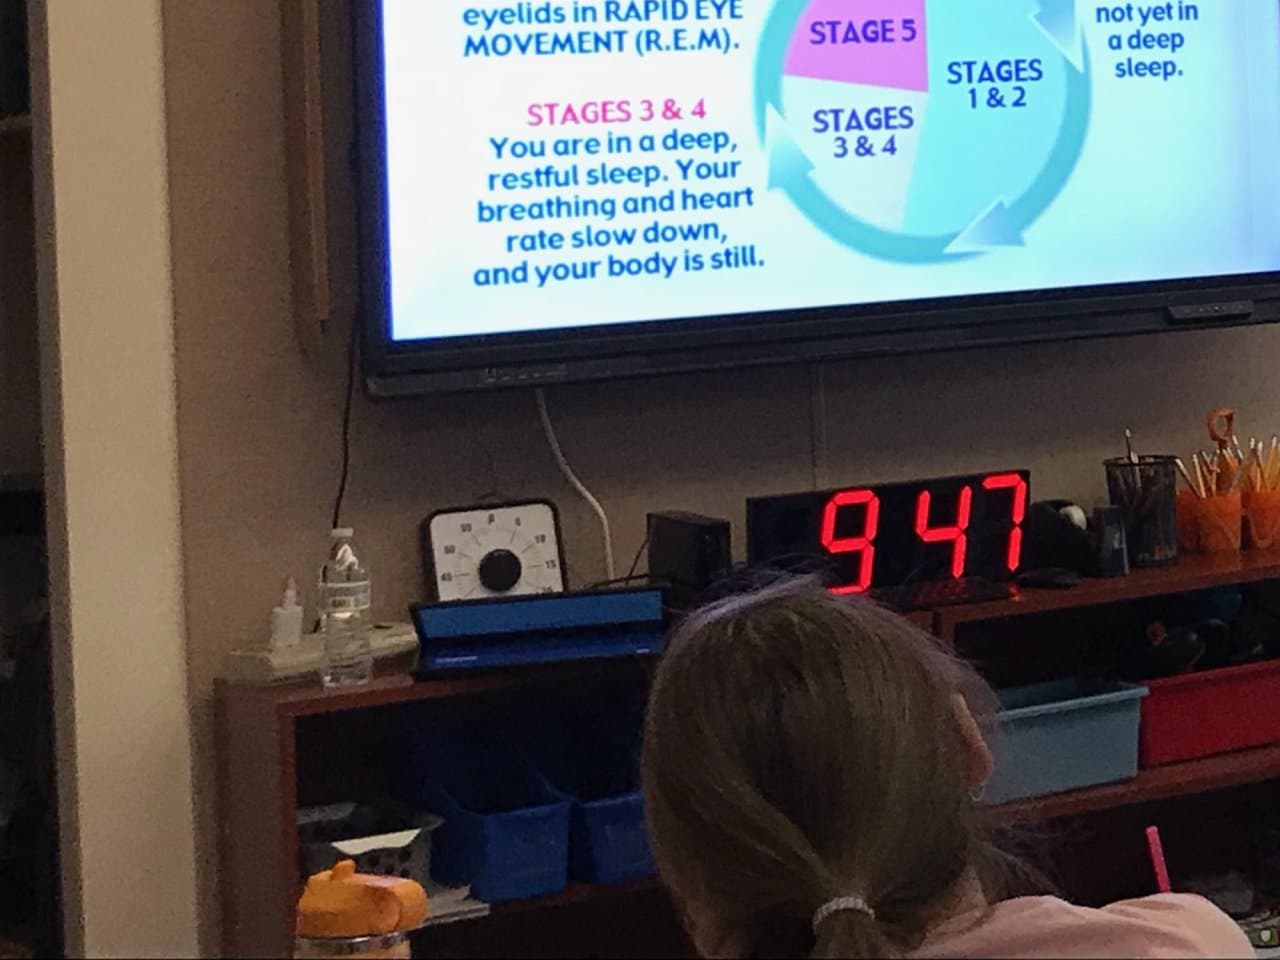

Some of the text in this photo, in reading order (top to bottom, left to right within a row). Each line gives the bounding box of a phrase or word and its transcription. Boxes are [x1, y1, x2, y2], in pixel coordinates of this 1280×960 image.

[463, 2, 567, 30] eyelids
[573, 1, 597, 24] in
[1095, 0, 1199, 28] not yet in
[464, 27, 740, 57] MOVEMENT (R.E.M).
[809, 18, 917, 45] STAGE 5
[1108, 30, 1185, 55] a deep
[946, 59, 1044, 85] STAGES
[1115, 57, 1184, 82] sleep.
[967, 86, 1027, 109] 1 & 2
[528, 97, 707, 127] STAGES 3 & 4
[812, 106, 914, 133] STAGES
[489, 128, 738, 160] You are in a deep,
[833, 134, 898, 159] 3 & 4
[488, 158, 742, 191] restful sleep. Your
[477, 187, 754, 223] breathing and heart
[506, 220, 728, 253] rate slow down,
[473, 244, 766, 287] and your body is still.
